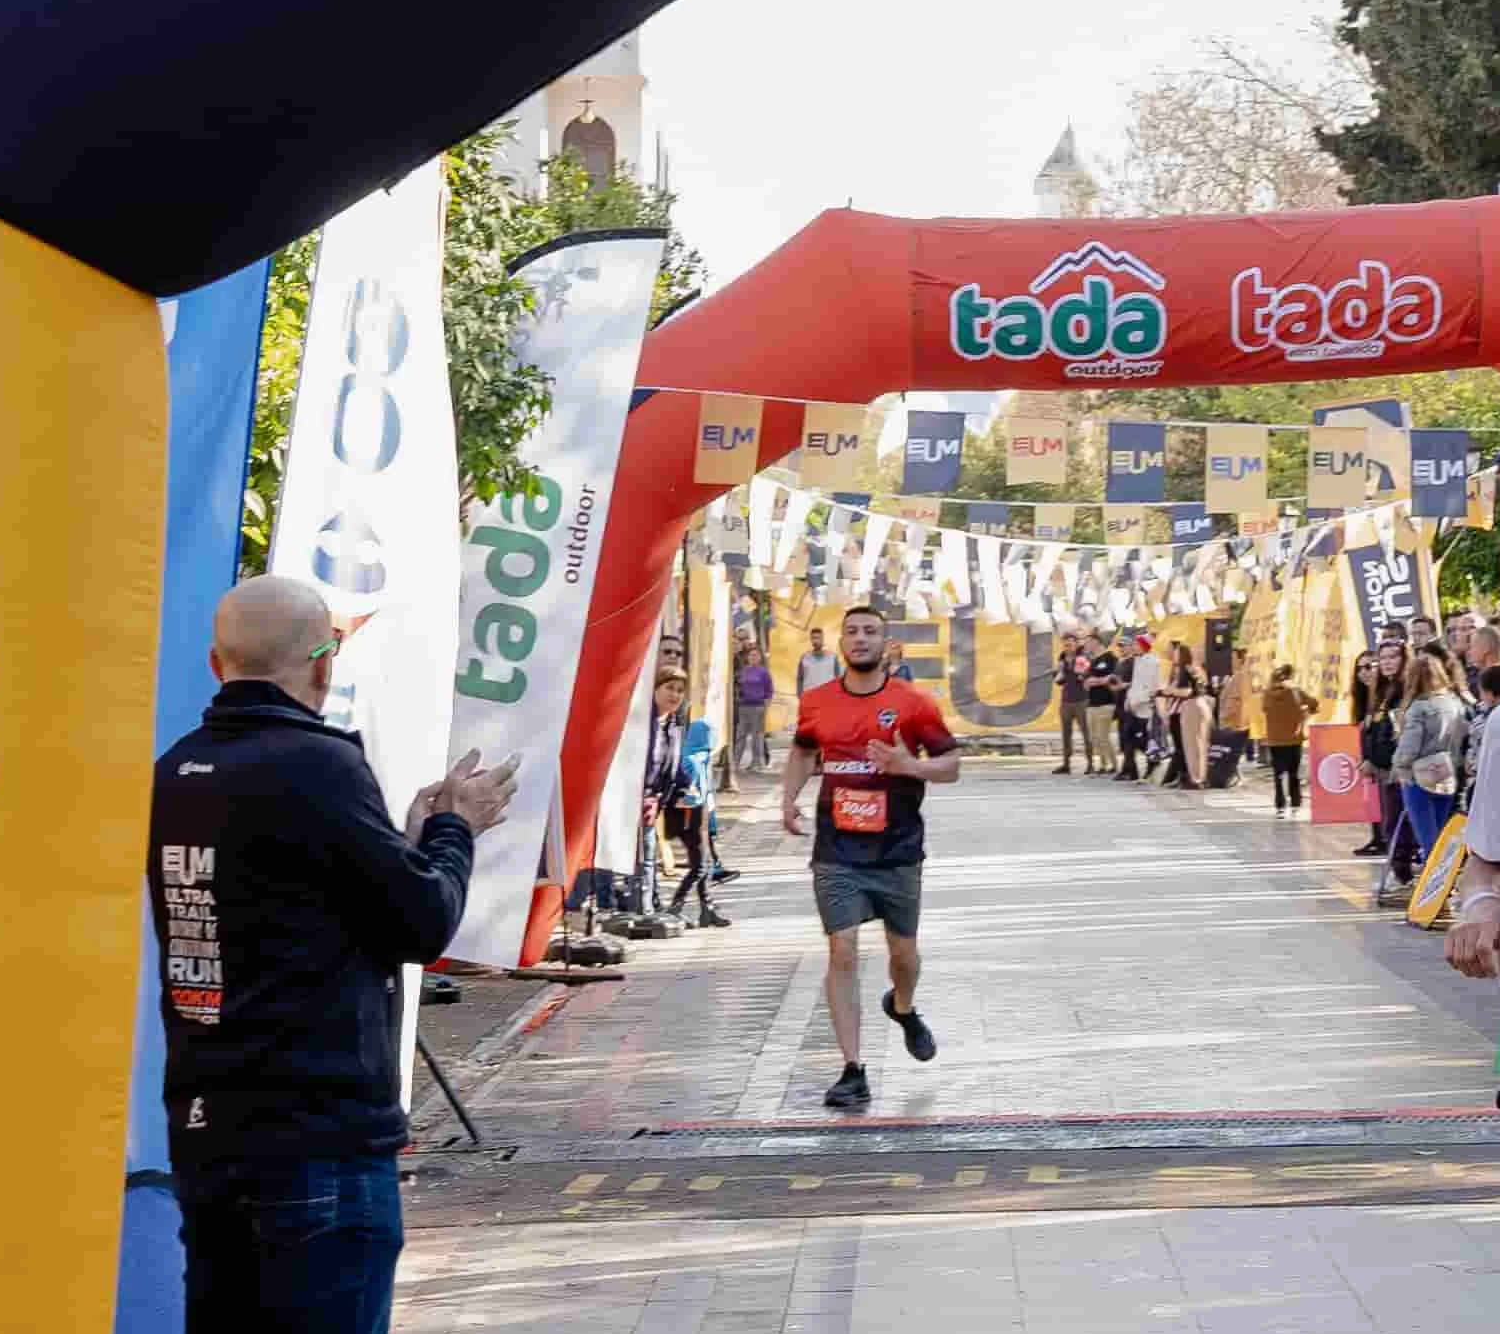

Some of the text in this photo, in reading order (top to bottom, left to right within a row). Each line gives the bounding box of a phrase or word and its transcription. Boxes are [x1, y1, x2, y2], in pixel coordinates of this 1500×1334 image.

[951, 261, 1443, 360] tada tada
[702, 424, 755, 451] EUM
[807, 433, 859, 457] EUM
[907, 438, 961, 462] EUM
[1012, 436, 1063, 457] EUM
[1112, 449, 1164, 475] EUM
[1211, 455, 1262, 480] EUM
[1313, 451, 1364, 476] EUM
[1412, 460, 1464, 485] EUM
[563, 484, 598, 584] outdoor
[1173, 517, 1212, 535] EUM
[455, 475, 563, 706] tada
[162, 845, 217, 886] EUM
[164, 887, 217, 905] ULTRA
[166, 904, 220, 921] TRAIL
[167, 957, 224, 983] RUN
